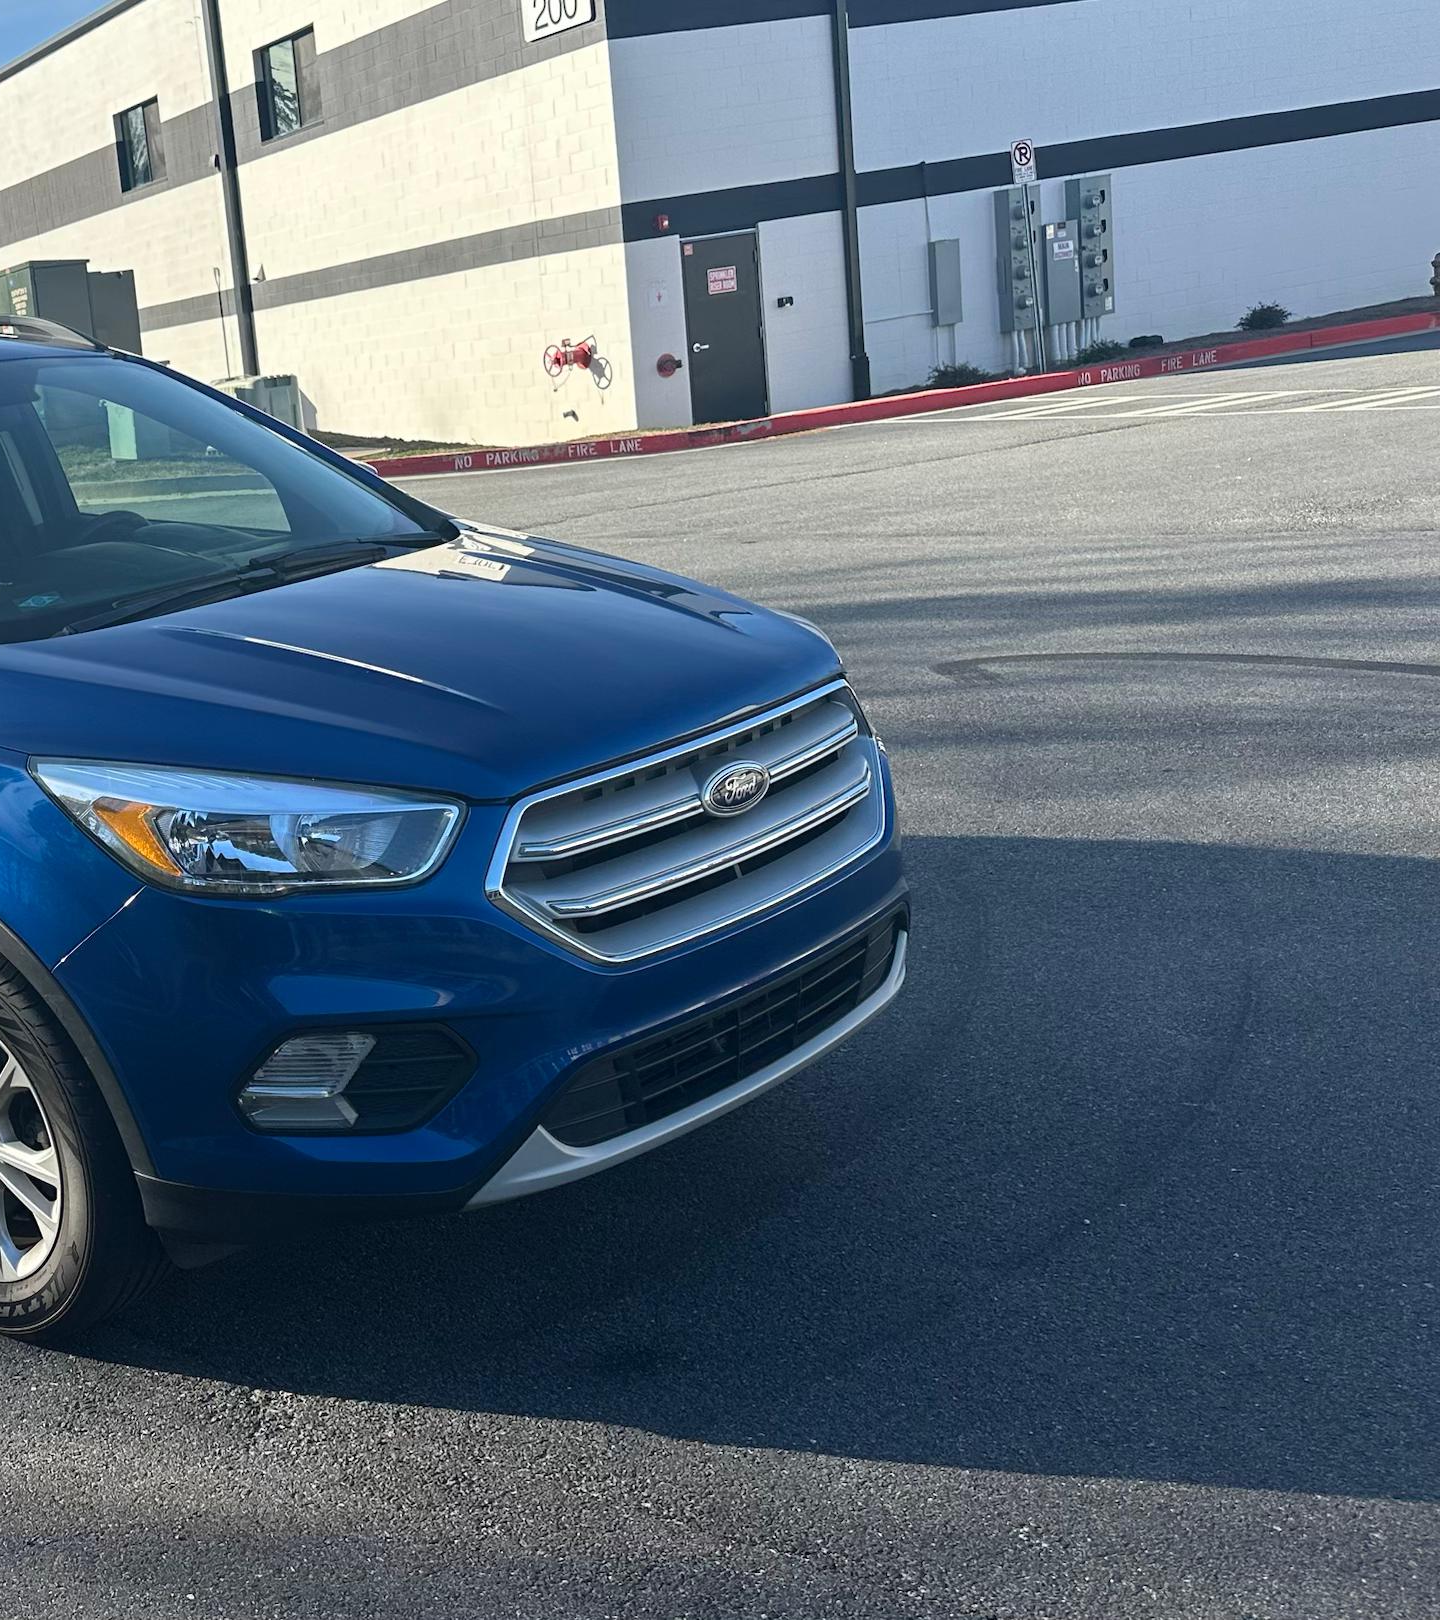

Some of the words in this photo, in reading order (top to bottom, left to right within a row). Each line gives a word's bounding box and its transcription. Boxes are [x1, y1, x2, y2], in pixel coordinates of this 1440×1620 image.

[533, 0, 577, 31] 200
[1078, 372, 1091, 386] NO
[1101, 364, 1141, 382] PARKING
[1161, 356, 1183, 372] FIRE
[1192, 350, 1217, 367] LANE
[454, 455, 472, 470] NO
[486, 449, 539, 466] PARKING
[568, 443, 598, 458] FIRE
[610, 438, 643, 453] LANE
[725, 773, 757, 804] Ford
